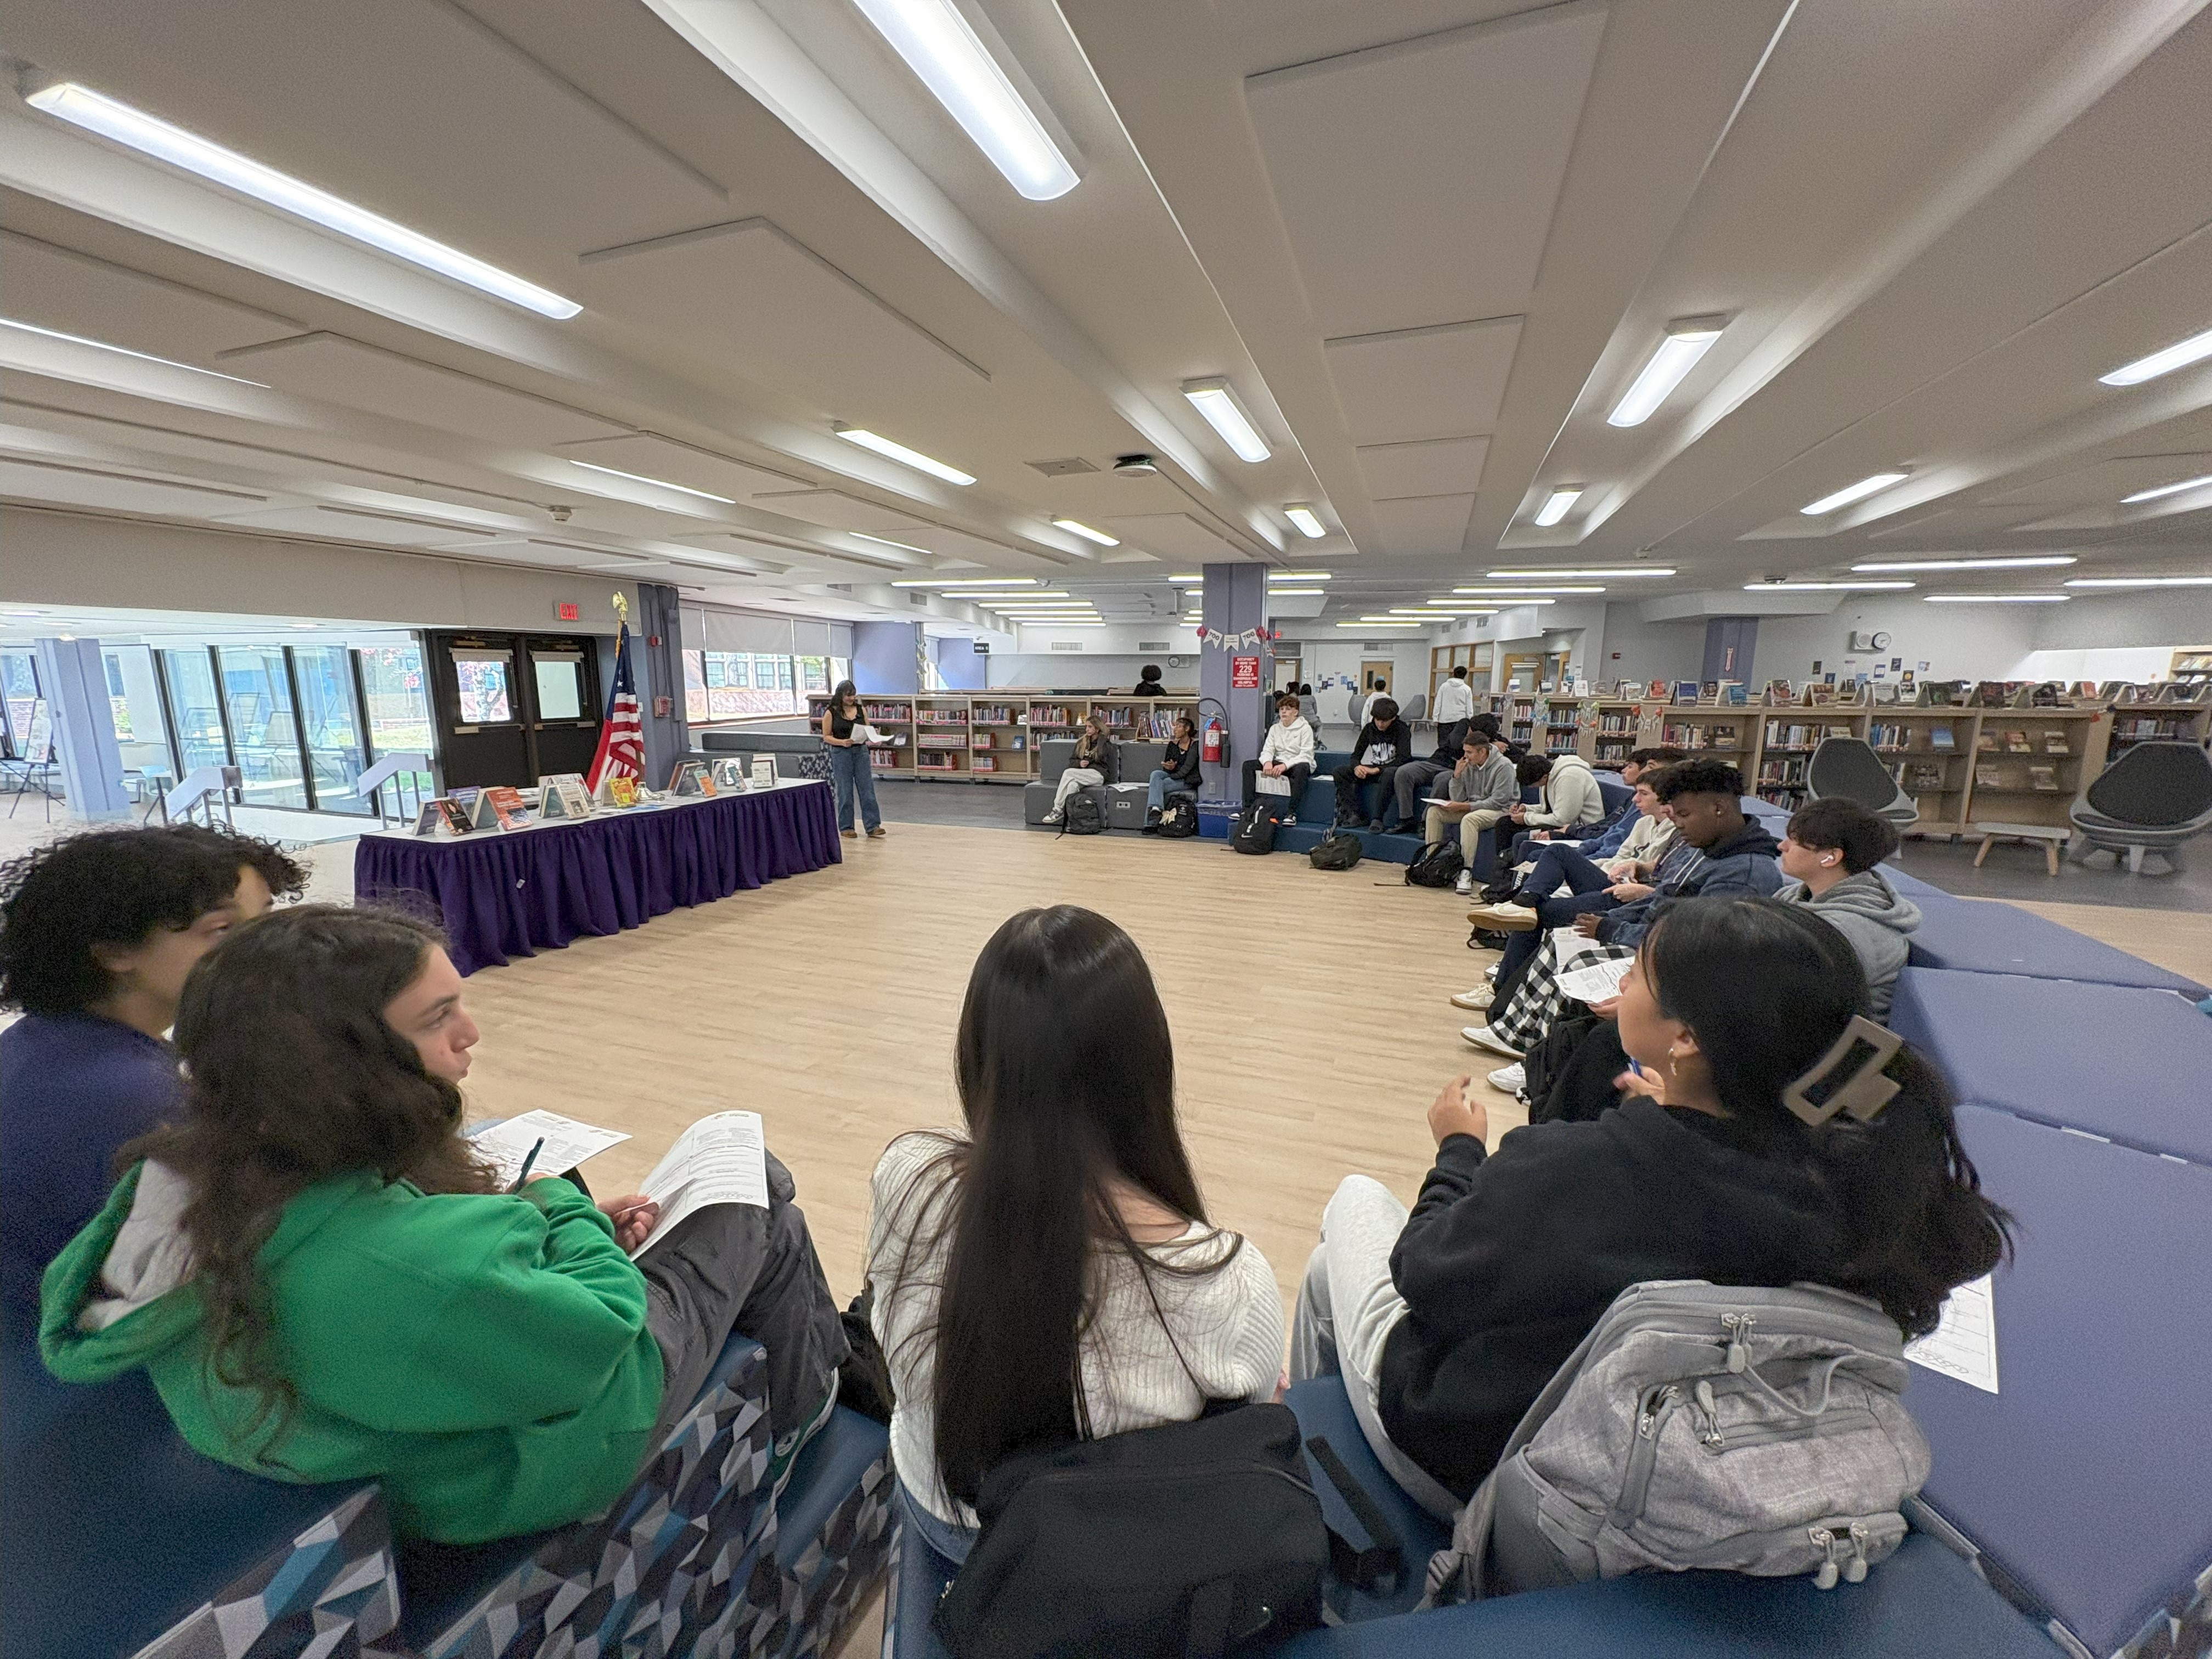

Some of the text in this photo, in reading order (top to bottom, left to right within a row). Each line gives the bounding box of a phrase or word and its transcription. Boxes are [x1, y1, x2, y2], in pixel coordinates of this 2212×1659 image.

[560, 603, 578, 620] EXIT
[1208, 631, 1220, 641] 700
[1243, 631, 1255, 641] 700
[1239, 665, 1252, 673] 229
